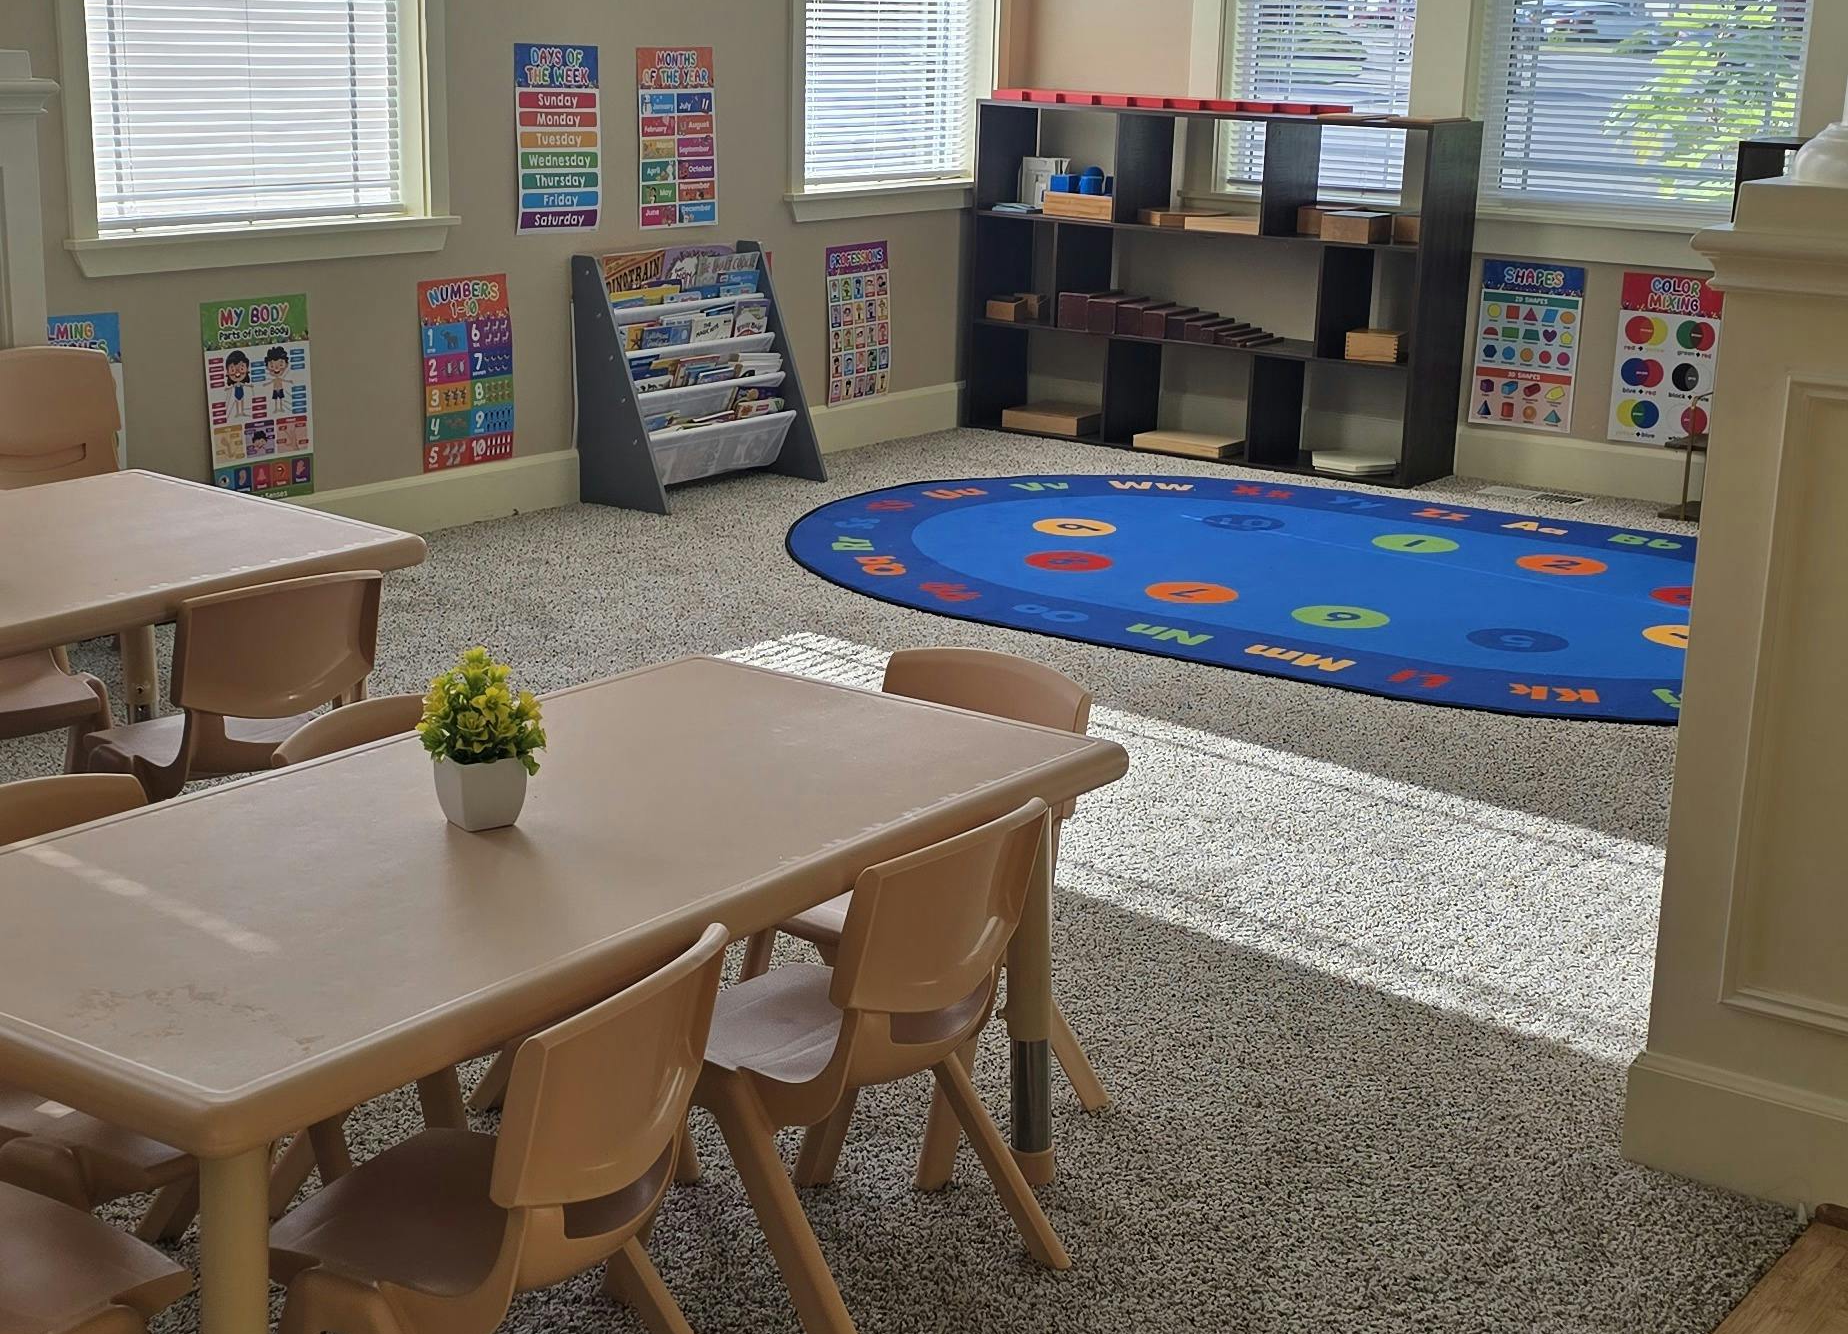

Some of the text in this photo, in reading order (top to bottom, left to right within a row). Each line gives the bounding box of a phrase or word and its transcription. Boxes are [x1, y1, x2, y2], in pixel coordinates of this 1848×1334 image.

[530, 47, 584, 67] DAYS OF
[656, 50, 698, 69] MONTHS
[525, 65, 590, 86] THE WEEK
[642, 67, 709, 86] OF THE YEAR
[538, 93, 578, 109] Sunday
[679, 102, 692, 111] July
[536, 113, 581, 128] Monday
[688, 121, 710, 130] August
[644, 125, 668, 134] February
[536, 133, 582, 148] Tuesday
[679, 145, 710, 155] September
[528, 154, 591, 169] Wednesday
[688, 165, 712, 173] October
[647, 166, 661, 176] April
[535, 174, 586, 188] Thursday
[679, 182, 710, 190] November
[543, 194, 579, 208] Friday
[660, 189, 673, 197] May
[645, 209, 660, 217] June
[681, 204, 712, 212] December
[534, 213, 585, 227] Saturday
[830, 247, 884, 269] PROFESSIONS
[1504, 266, 1565, 288] SHAPES
[427, 280, 499, 308] NUMBERS
[1651, 277, 1701, 297] COLOR
[450, 299, 479, 318] 1-10
[1525, 297, 1548, 305] SHAPES
[1648, 293, 1699, 313] MIXING
[218, 302, 289, 328] MY BODY
[218, 325, 290, 341] Parts of the Body
[427, 328, 433, 347] 1
[471, 323, 481, 341] 6
[428, 358, 438, 377] 2
[474, 352, 483, 370] 7
[1517, 372, 1541, 380] SHAPES
[431, 389, 440, 407] 3
[475, 382, 484, 399] 8
[430, 418, 440, 435] 4
[476, 411, 485, 428] 9
[428, 447, 439, 464] 5
[472, 439, 486, 457] 10
[1009, 481, 1069, 492] Vv
[1108, 480, 1194, 492] Ww
[1500, 521, 1569, 536] Aa
[1607, 533, 1683, 550] Bb
[1542, 559, 1582, 571] 2
[1125, 622, 1216, 646] Nn
[1244, 644, 1358, 672] Mm
[1509, 682, 1602, 705] Kk
